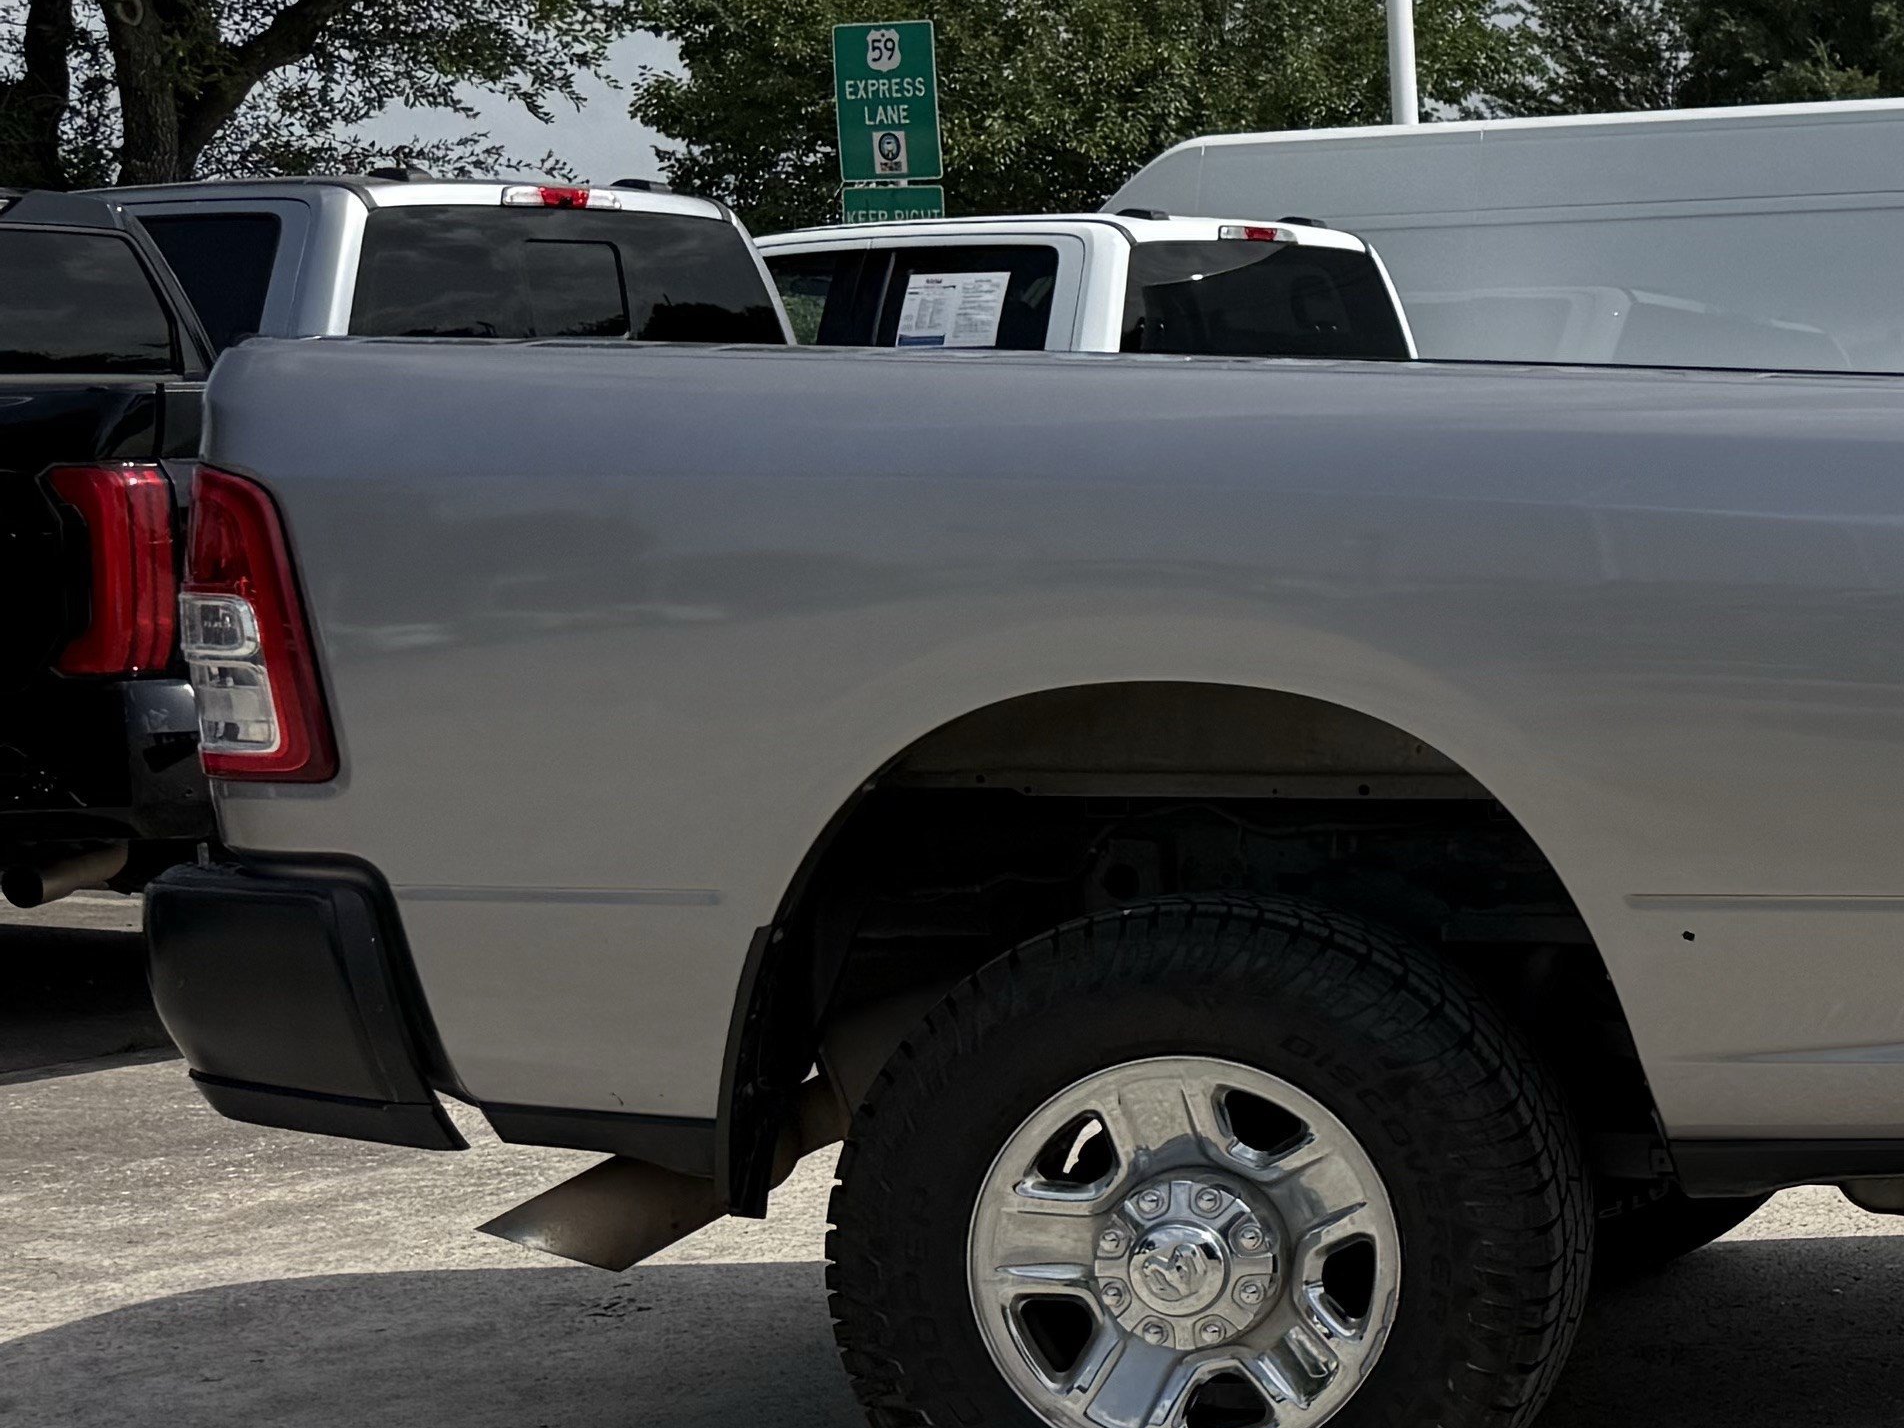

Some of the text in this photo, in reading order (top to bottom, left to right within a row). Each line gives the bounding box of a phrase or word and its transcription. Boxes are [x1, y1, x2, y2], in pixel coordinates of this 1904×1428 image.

[871, 38, 896, 63] 59
[845, 77, 926, 100] EXPRESS
[864, 104, 911, 126] LANE
